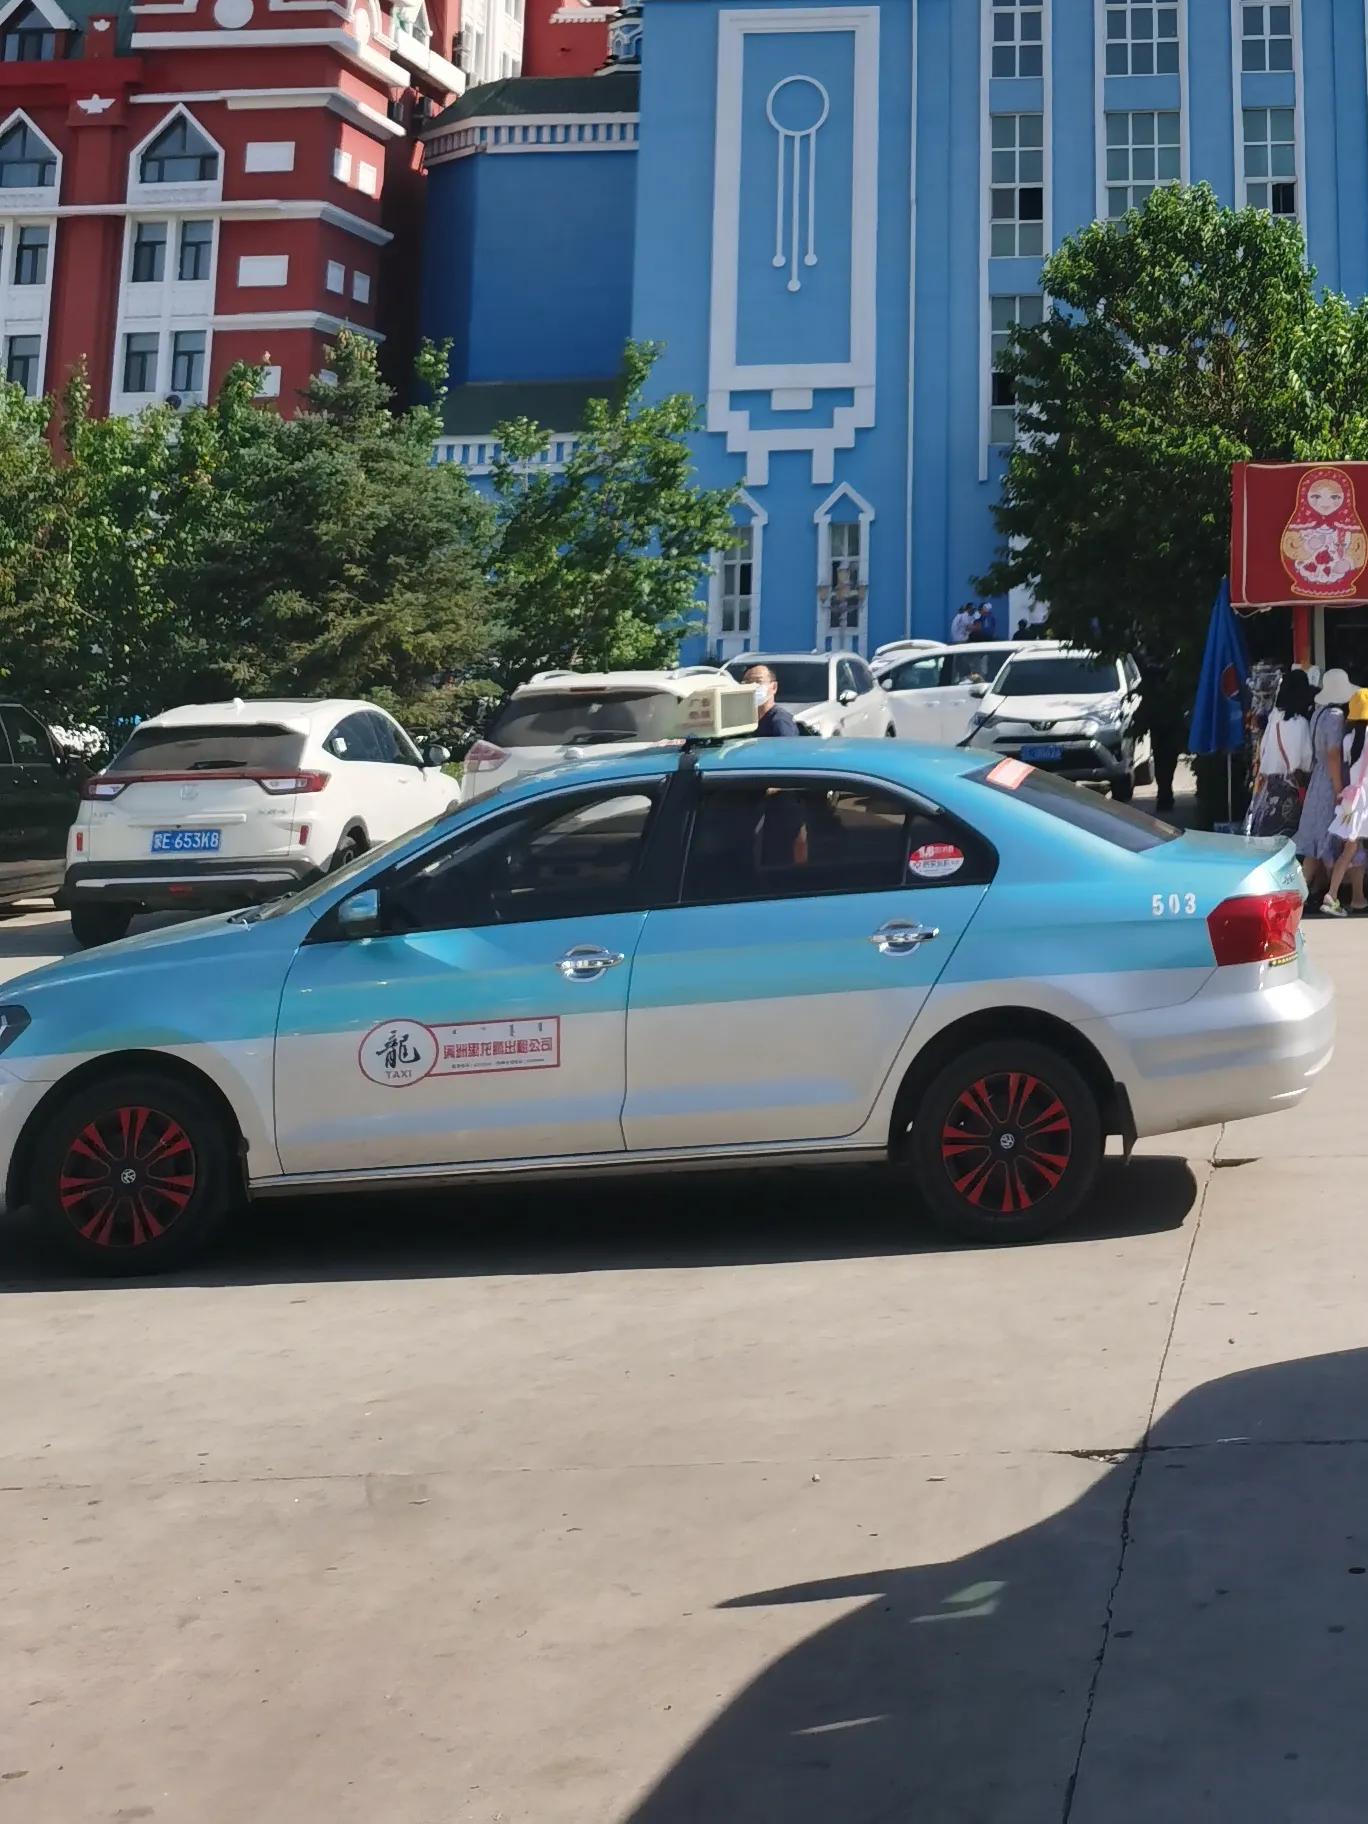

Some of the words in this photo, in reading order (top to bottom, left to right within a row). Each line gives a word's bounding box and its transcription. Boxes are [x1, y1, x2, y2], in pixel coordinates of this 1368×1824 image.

[1152, 892, 1197, 916] 503
[376, 1029, 421, 1069] 龍
[385, 1069, 412, 1079] TAXI
